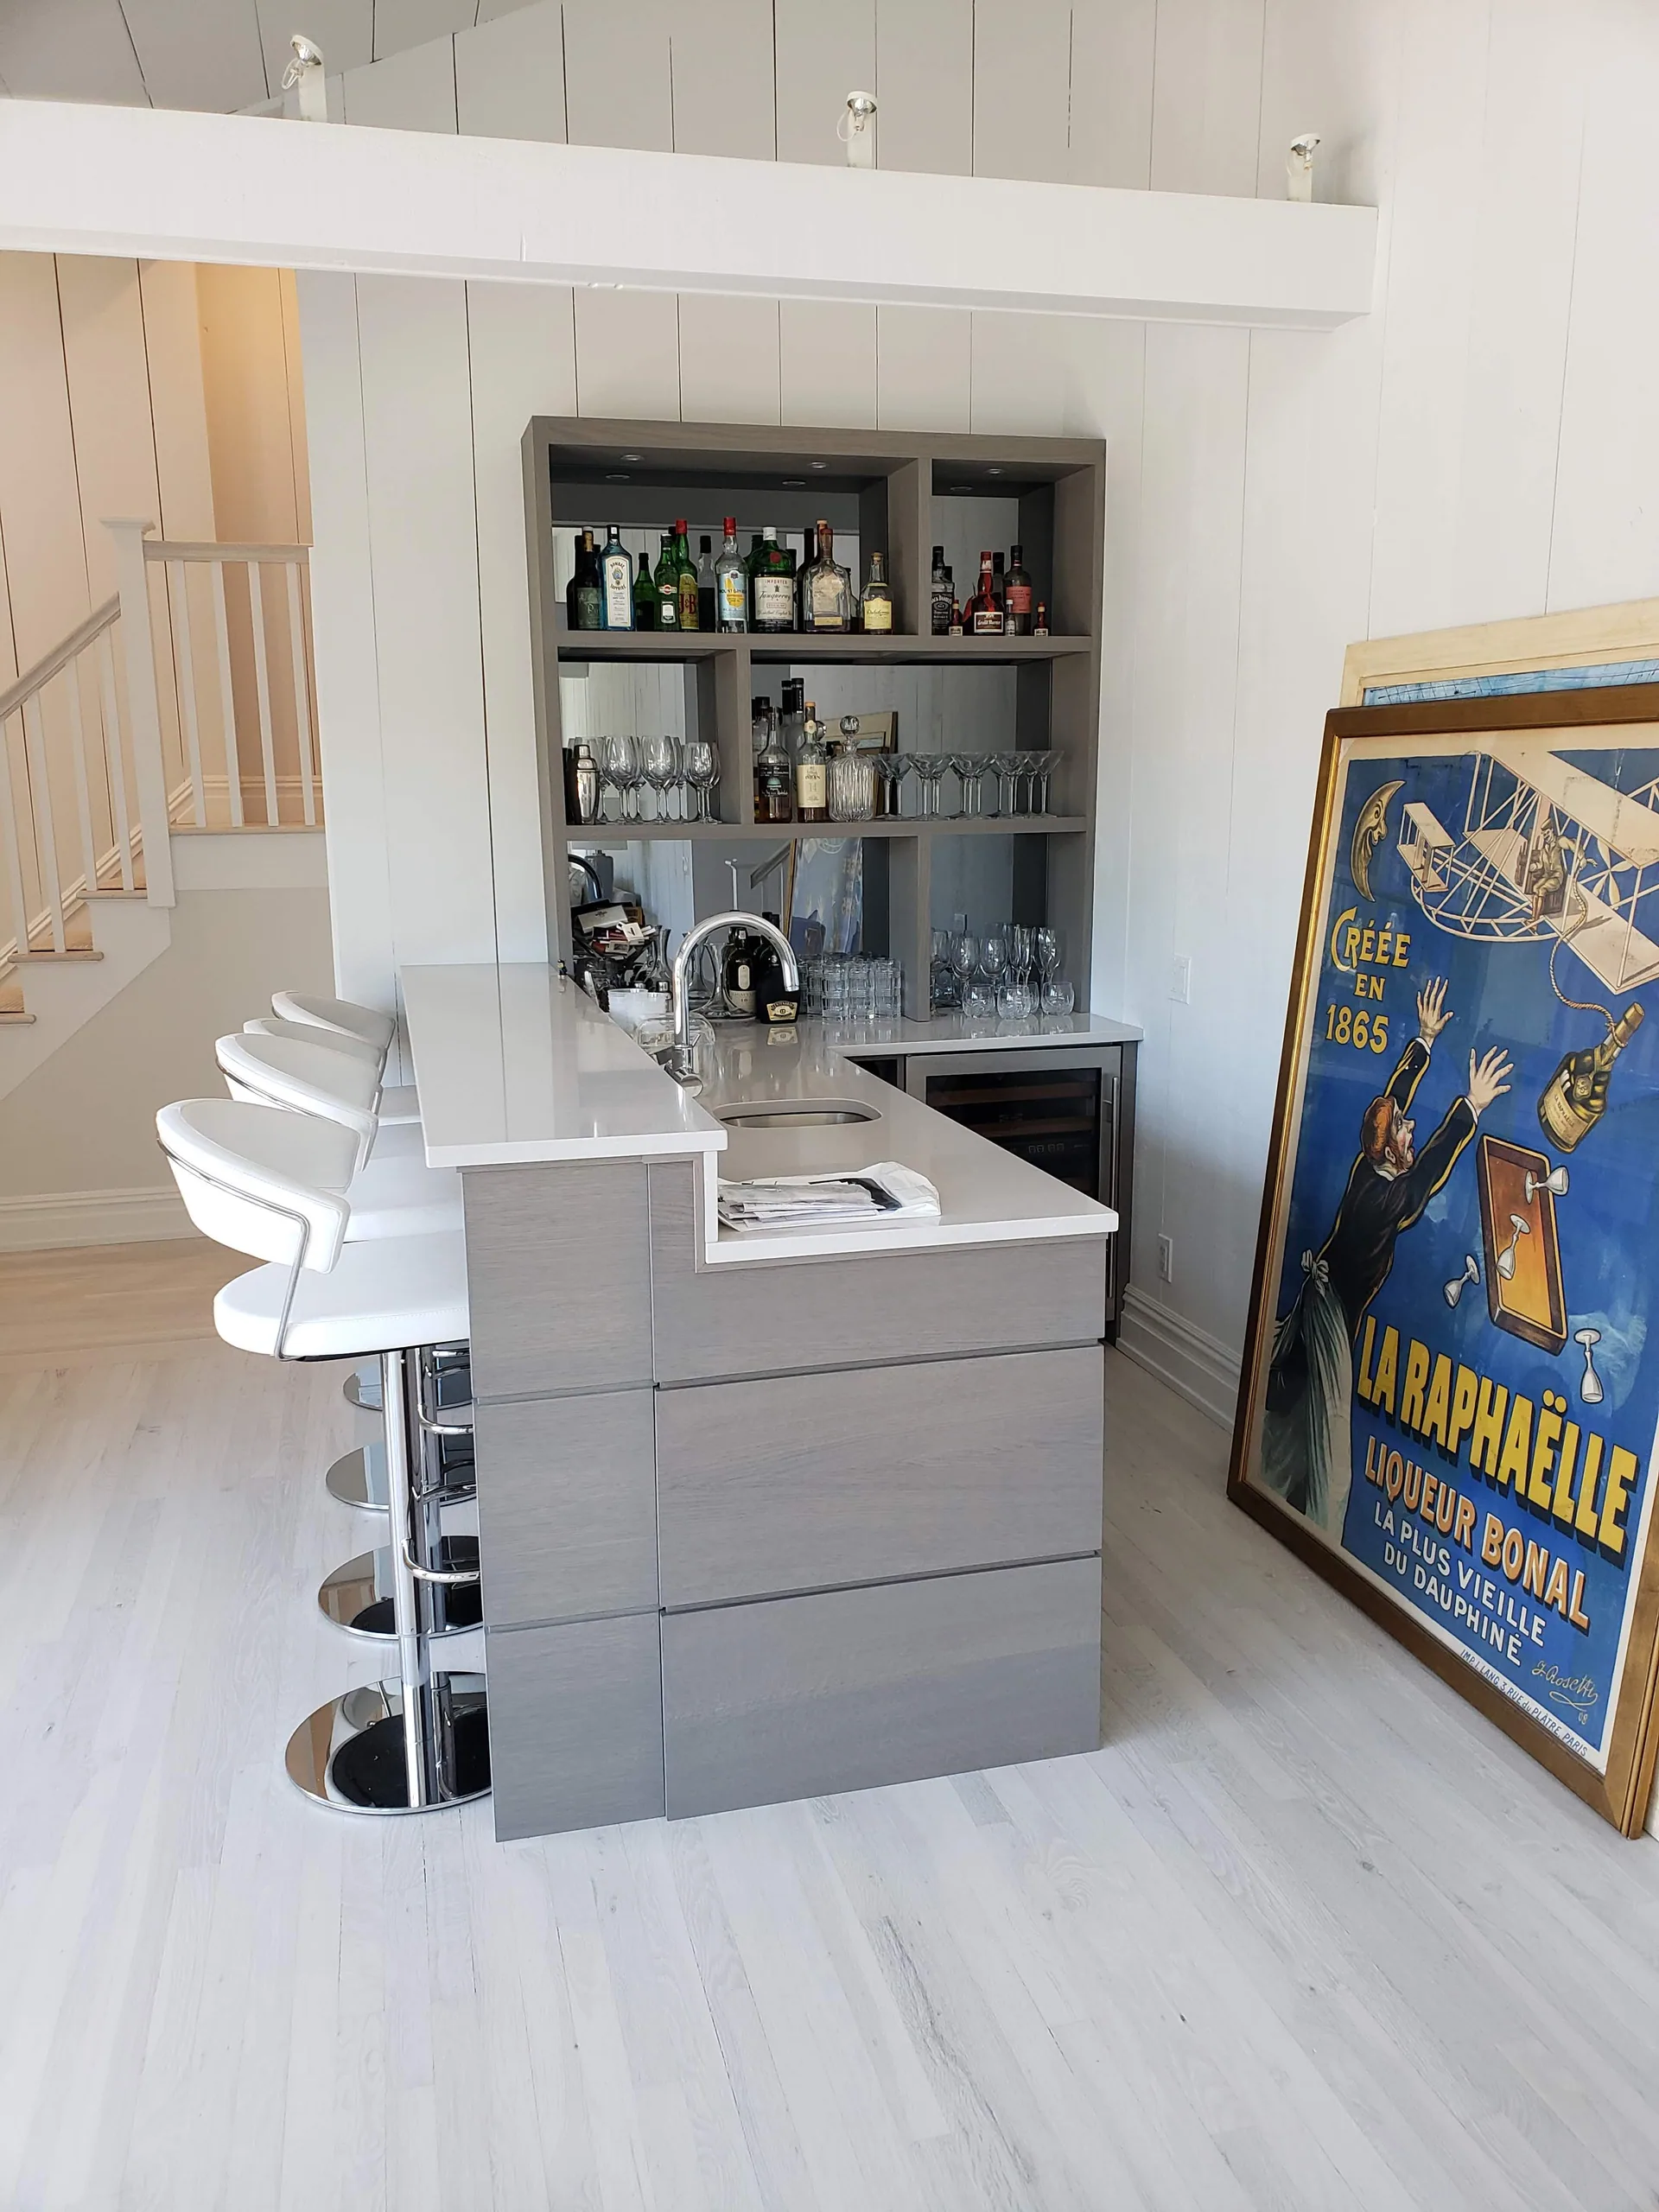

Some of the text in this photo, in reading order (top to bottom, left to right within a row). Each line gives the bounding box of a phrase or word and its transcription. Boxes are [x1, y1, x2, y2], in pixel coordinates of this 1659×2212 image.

[759, 590, 791, 602] Tanqueray
[1332, 906, 1411, 972] CRÉÉE
[1354, 973, 1386, 1001] EN
[1325, 1003, 1389, 1054] 1865
[1357, 1315, 1639, 1555] LA RAPHAËLLE
[1364, 1434, 1591, 1631] LIQUEUR BONAL
[1374, 1501, 1546, 1648] LA PLUS VIEILLE
[1384, 1540, 1522, 1668] DU DAUPHINÉ
[1506, 1687, 1524, 1705] RUE
[1522, 1699, 1532, 1713] du
[1561, 1732, 1588, 1757] PARIS
